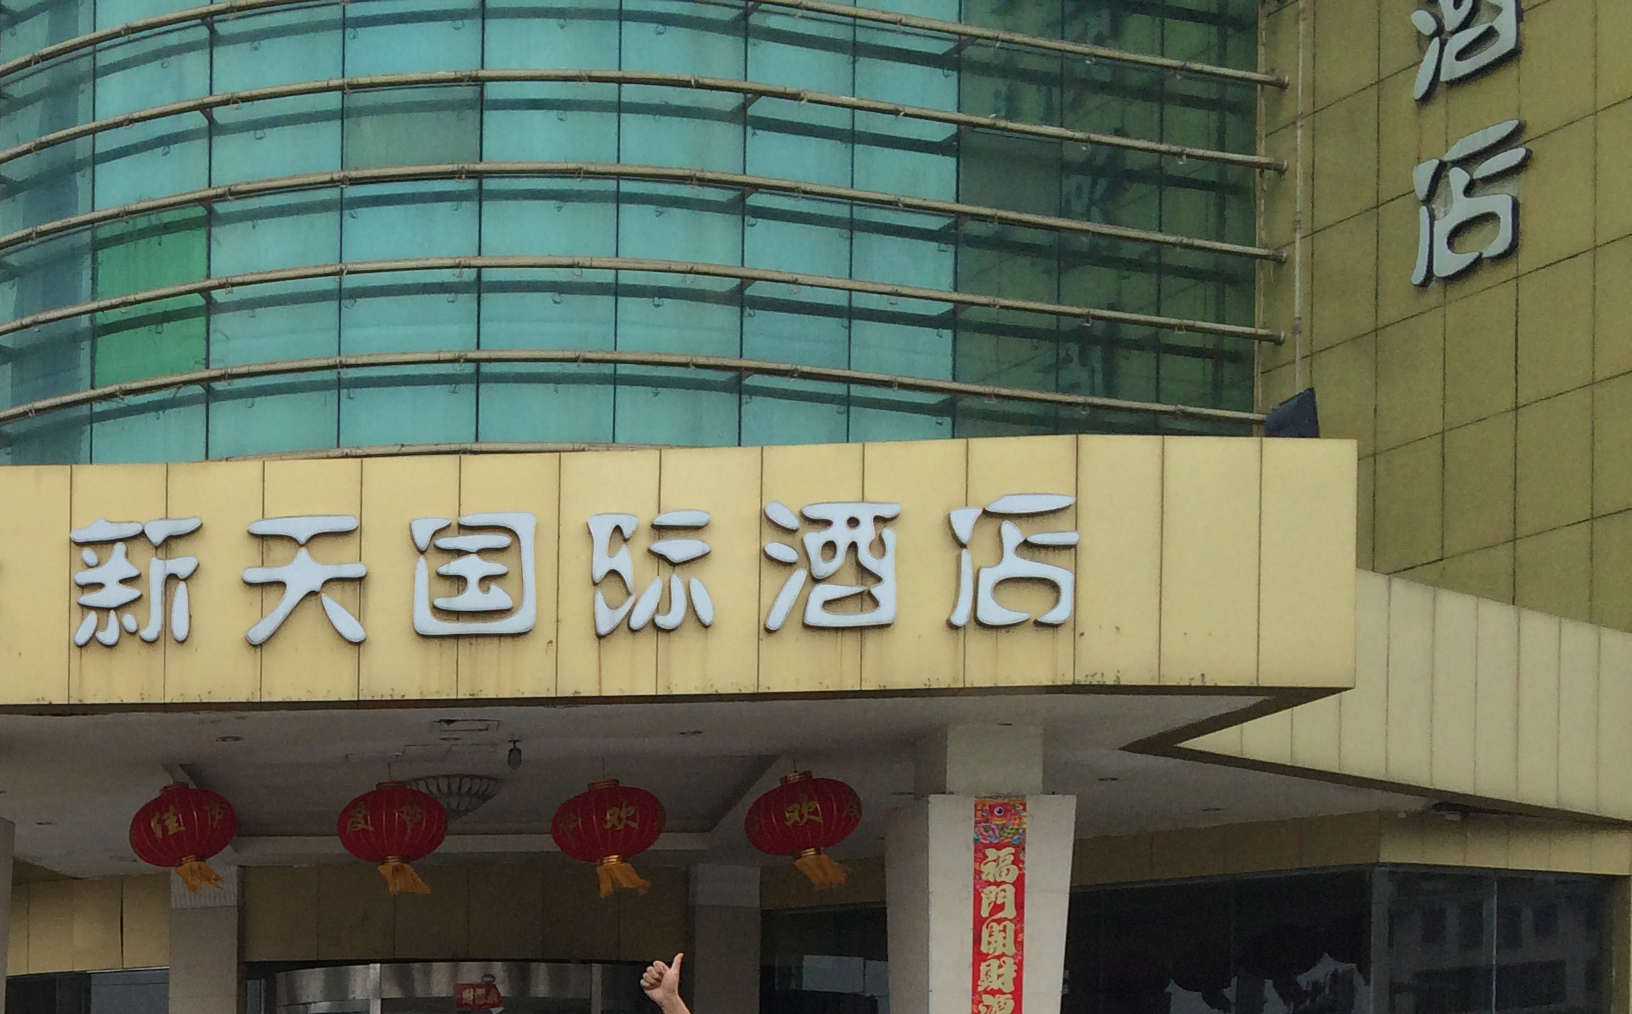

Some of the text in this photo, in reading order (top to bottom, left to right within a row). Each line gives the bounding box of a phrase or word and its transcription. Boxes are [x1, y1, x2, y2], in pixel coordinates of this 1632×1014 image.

[70, 491, 1082, 648] 新天国际酒店
